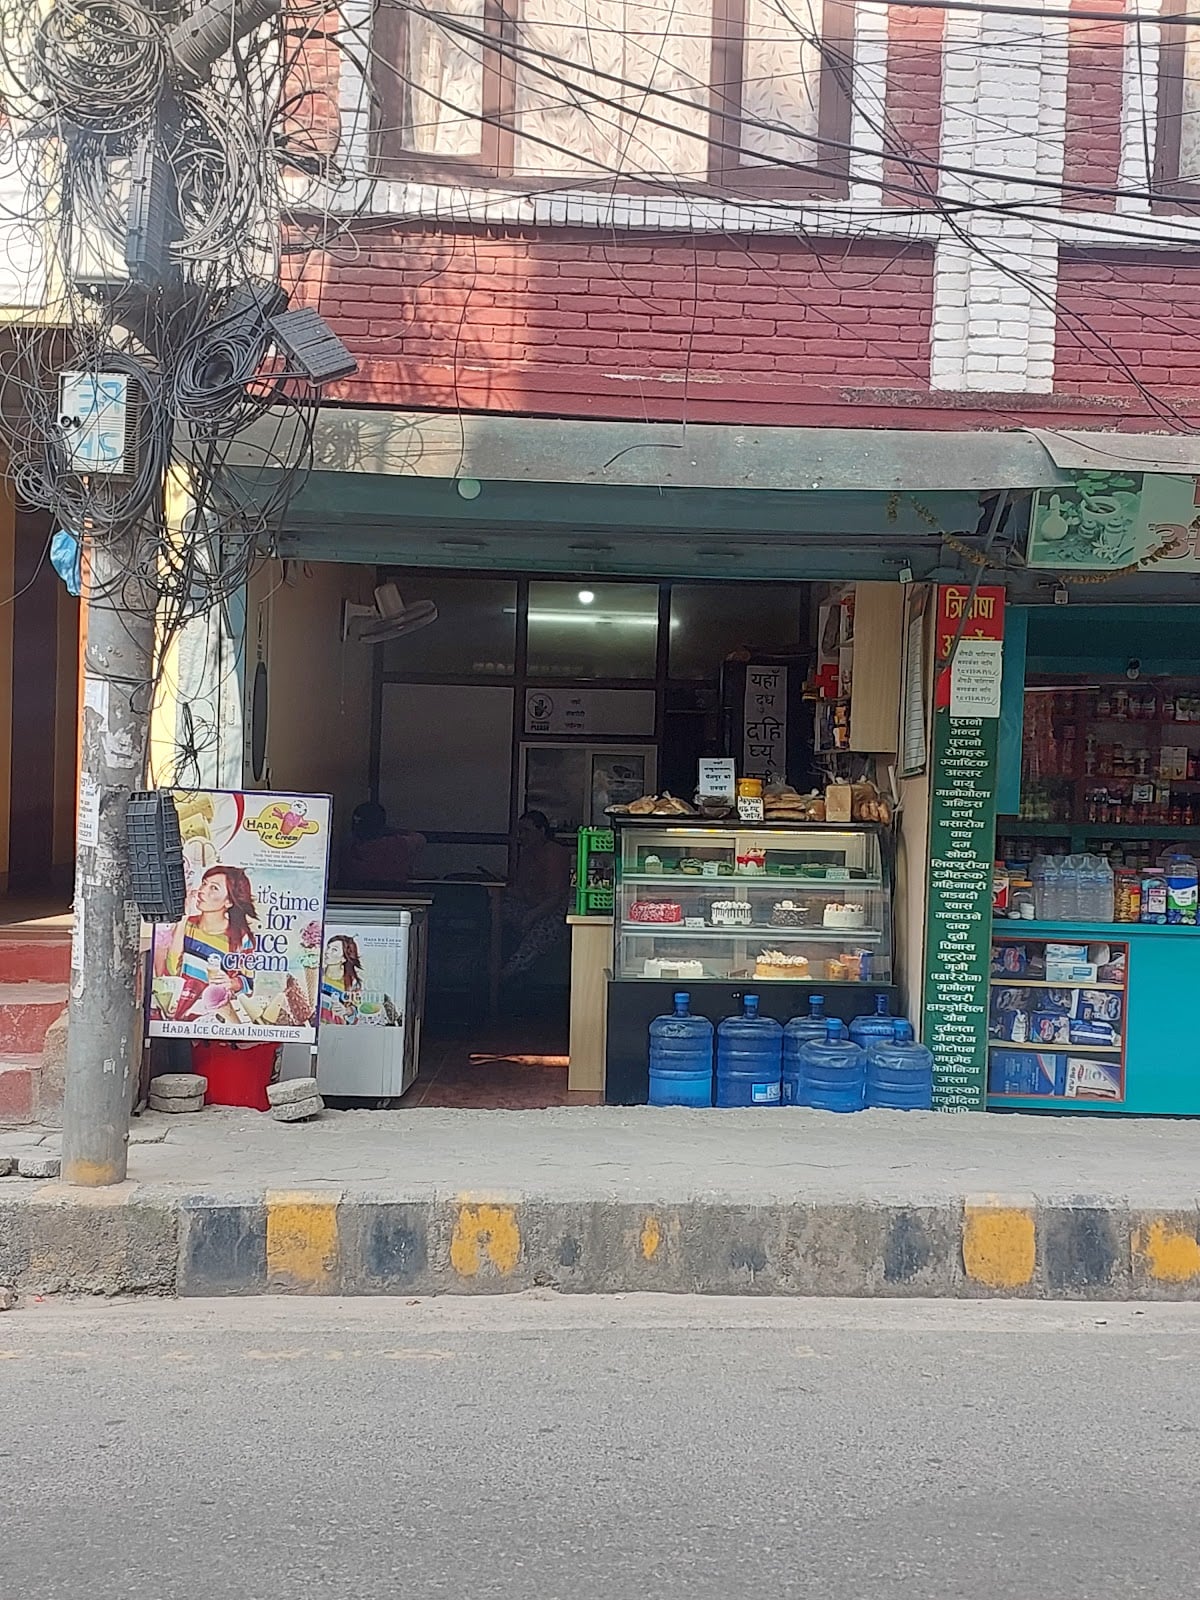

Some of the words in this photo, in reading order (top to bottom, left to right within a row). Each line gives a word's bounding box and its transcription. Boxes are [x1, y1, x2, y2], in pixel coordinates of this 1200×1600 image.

[750, 673, 780, 689] यहाँ
[746, 717, 784, 742] दहि
[949, 738, 982, 747] पुरानो
[246, 819, 279, 831] HADA
[260, 831, 273, 841] Ice
[275, 832, 298, 841] Cream
[257, 885, 277, 904] it's
[279, 890, 320, 912] time
[265, 905, 297, 930] for
[254, 924, 288, 954] ice
[223, 953, 289, 972] cream
[162, 1023, 190, 1034] HADA
[193, 1024, 209, 1035] ICE
[211, 1025, 245, 1037] CREAM
[247, 1026, 300, 1039] INDUSTRIES
[932, 1084, 980, 1094] ोगहरुको
